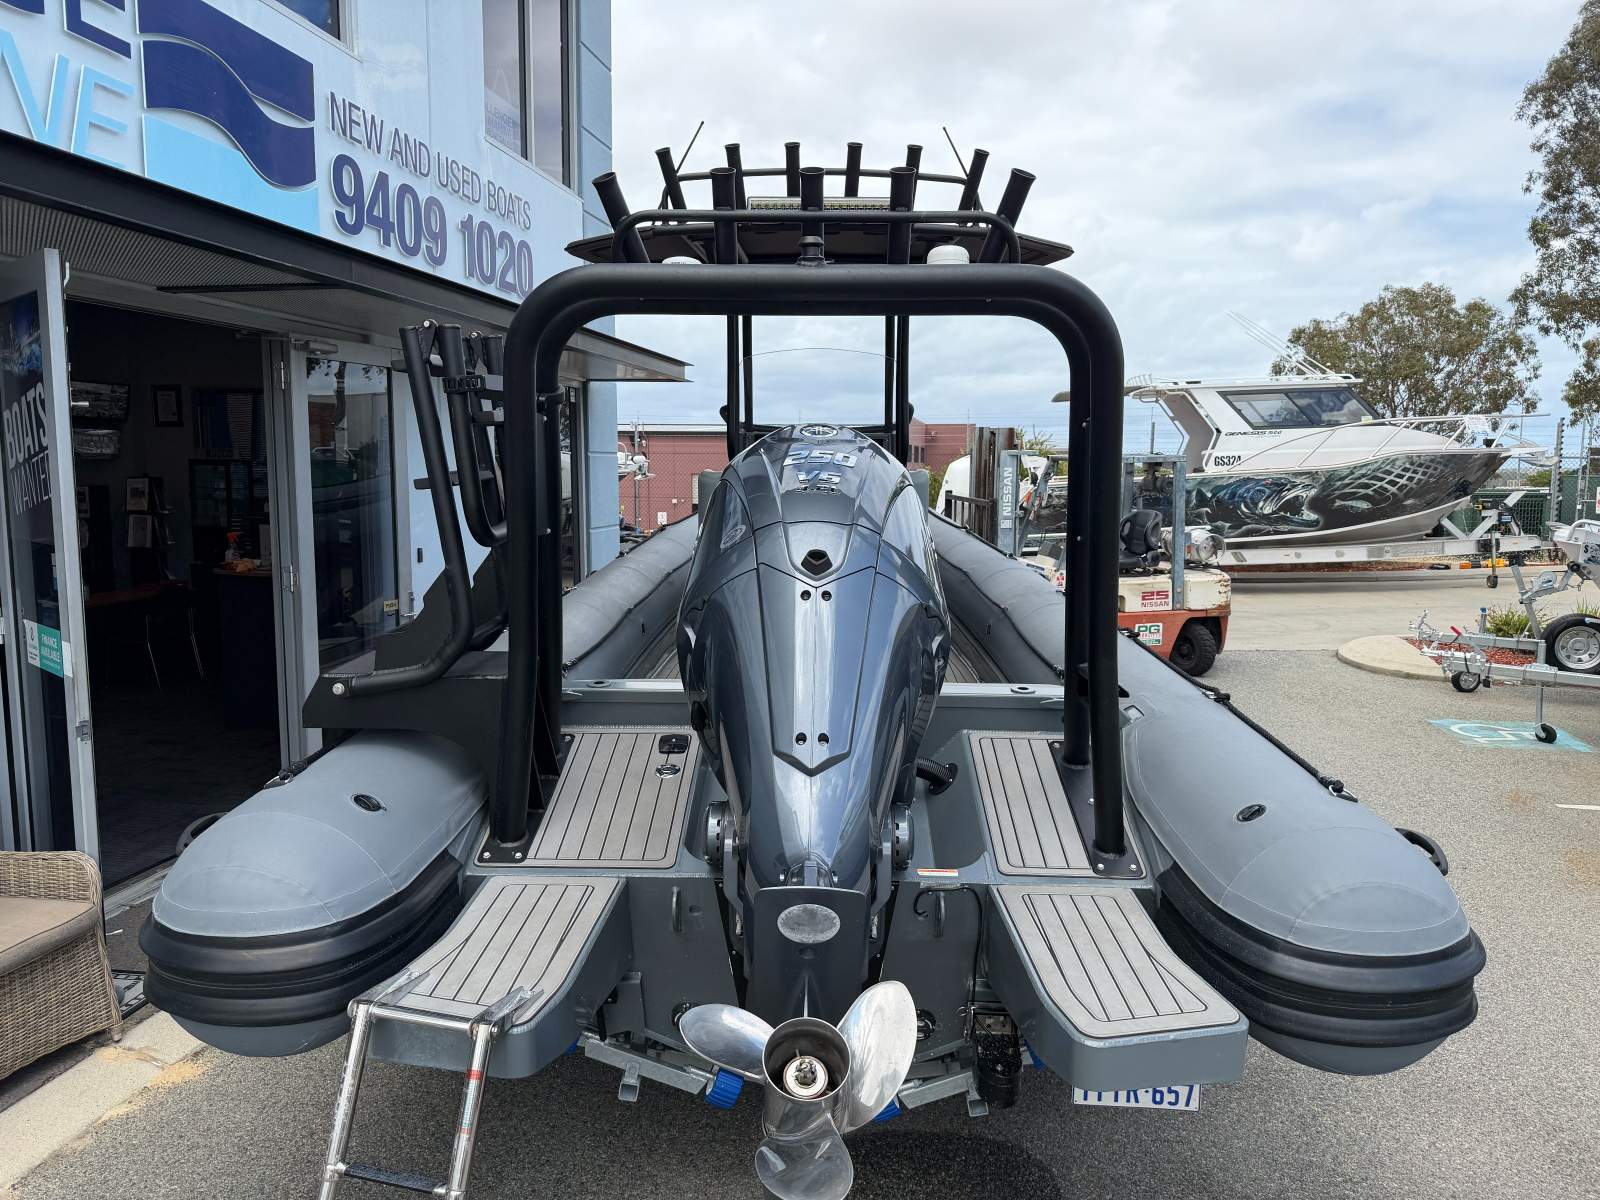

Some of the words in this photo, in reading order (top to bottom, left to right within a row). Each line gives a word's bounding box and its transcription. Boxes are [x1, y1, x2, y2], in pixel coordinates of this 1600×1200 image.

[329, 91, 384, 155] NEW
[388, 127, 431, 178] AND
[436, 151, 482, 204] USED
[486, 179, 532, 231] BOATS
[330, 153, 448, 267] 9409
[458, 213, 534, 300] 1020
[3, 382, 48, 469] BOATS
[783, 449, 858, 468] 250
[1002, 467, 1013, 516] NISSAN
[1141, 590, 1169, 601] 25
[1141, 600, 1170, 608] NISSAN
[1137, 624, 1161, 634] PG
